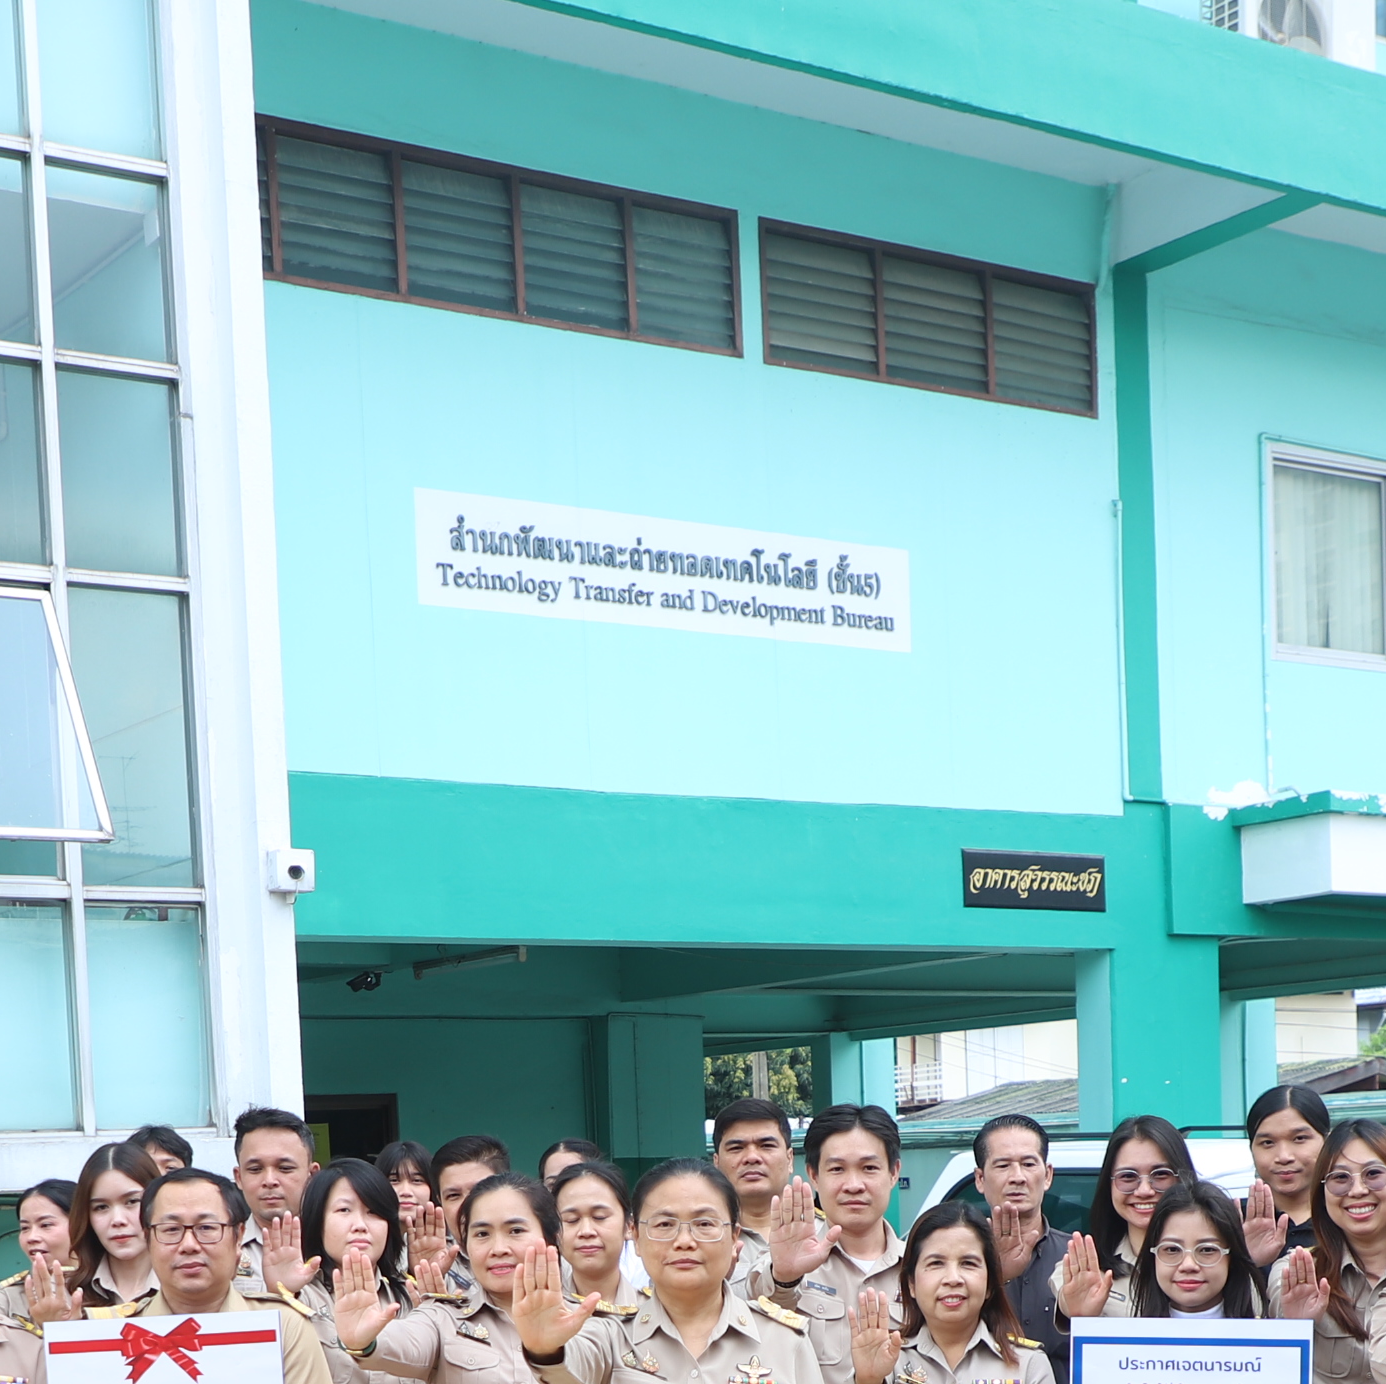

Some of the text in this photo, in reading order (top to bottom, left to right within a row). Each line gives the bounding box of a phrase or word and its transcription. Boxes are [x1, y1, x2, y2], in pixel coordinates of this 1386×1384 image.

[448, 515, 818, 590] สำนักพัฒนาและถ่ายทอดเทคโนโลยี
[437, 563, 894, 631] Technology Transfer and Development Bureau
[1119, 1357, 1261, 1373] ประกาศเจตนารมณ์
